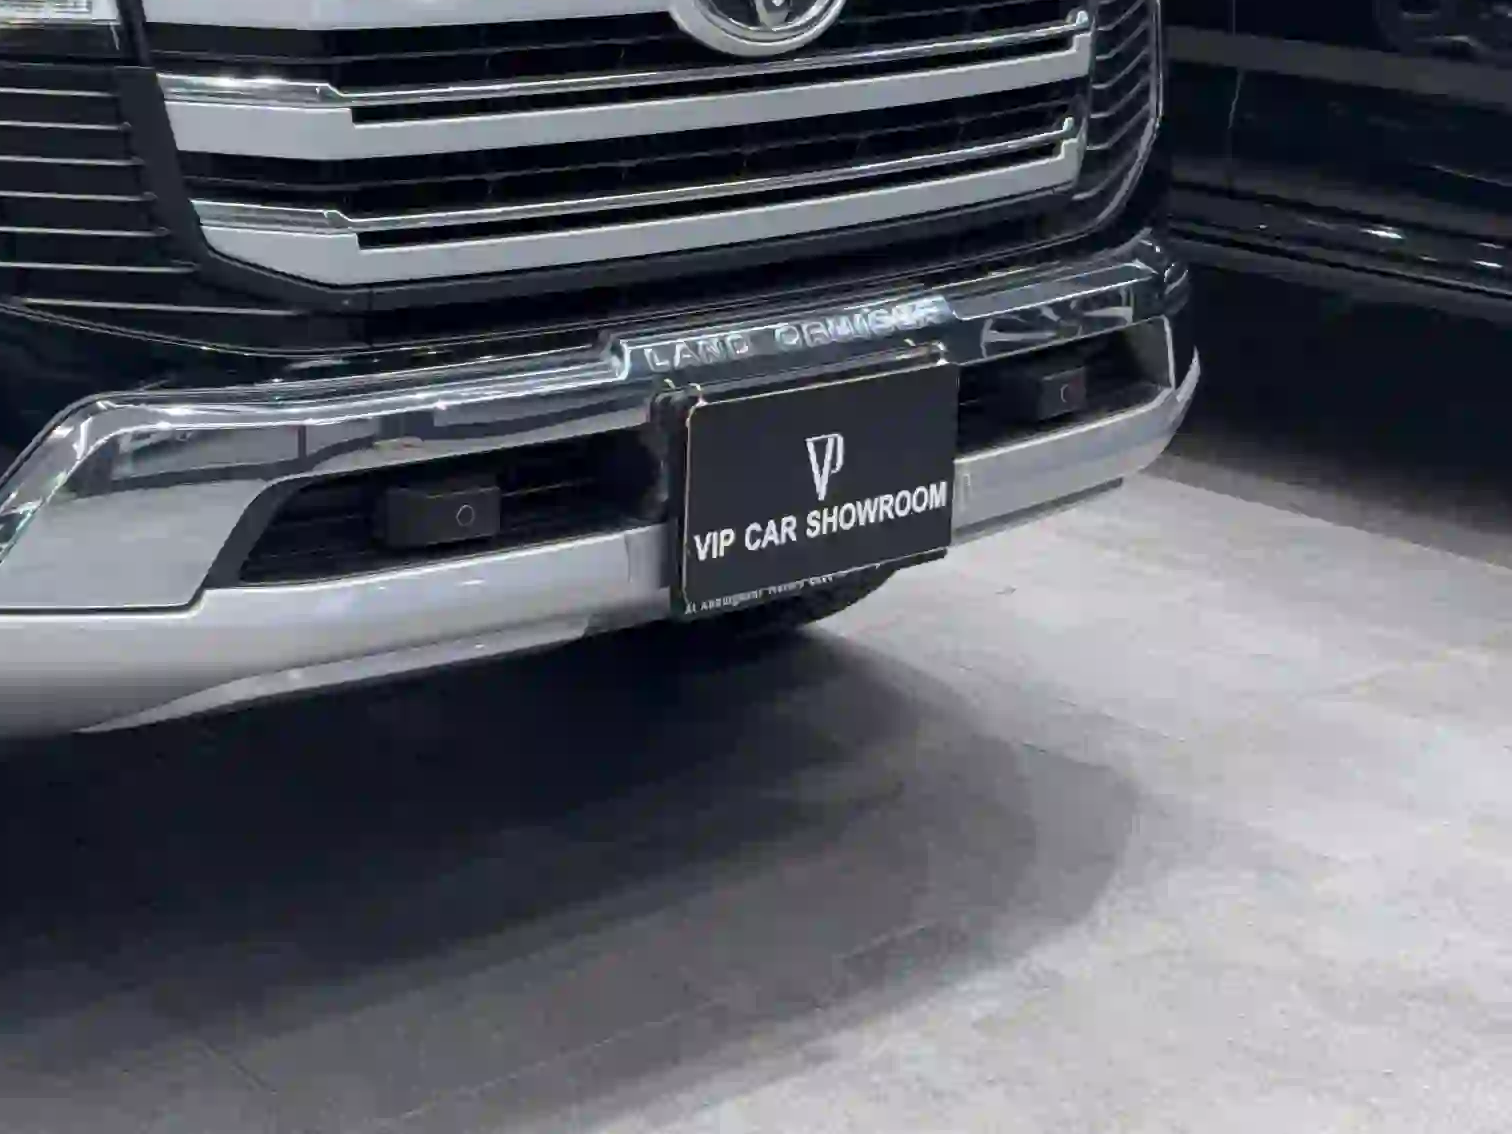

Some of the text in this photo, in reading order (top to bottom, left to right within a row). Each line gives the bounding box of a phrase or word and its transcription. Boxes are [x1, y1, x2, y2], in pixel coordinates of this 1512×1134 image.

[644, 333, 750, 372] LAND
[692, 481, 948, 562] VIP CAR SHOWROOM
